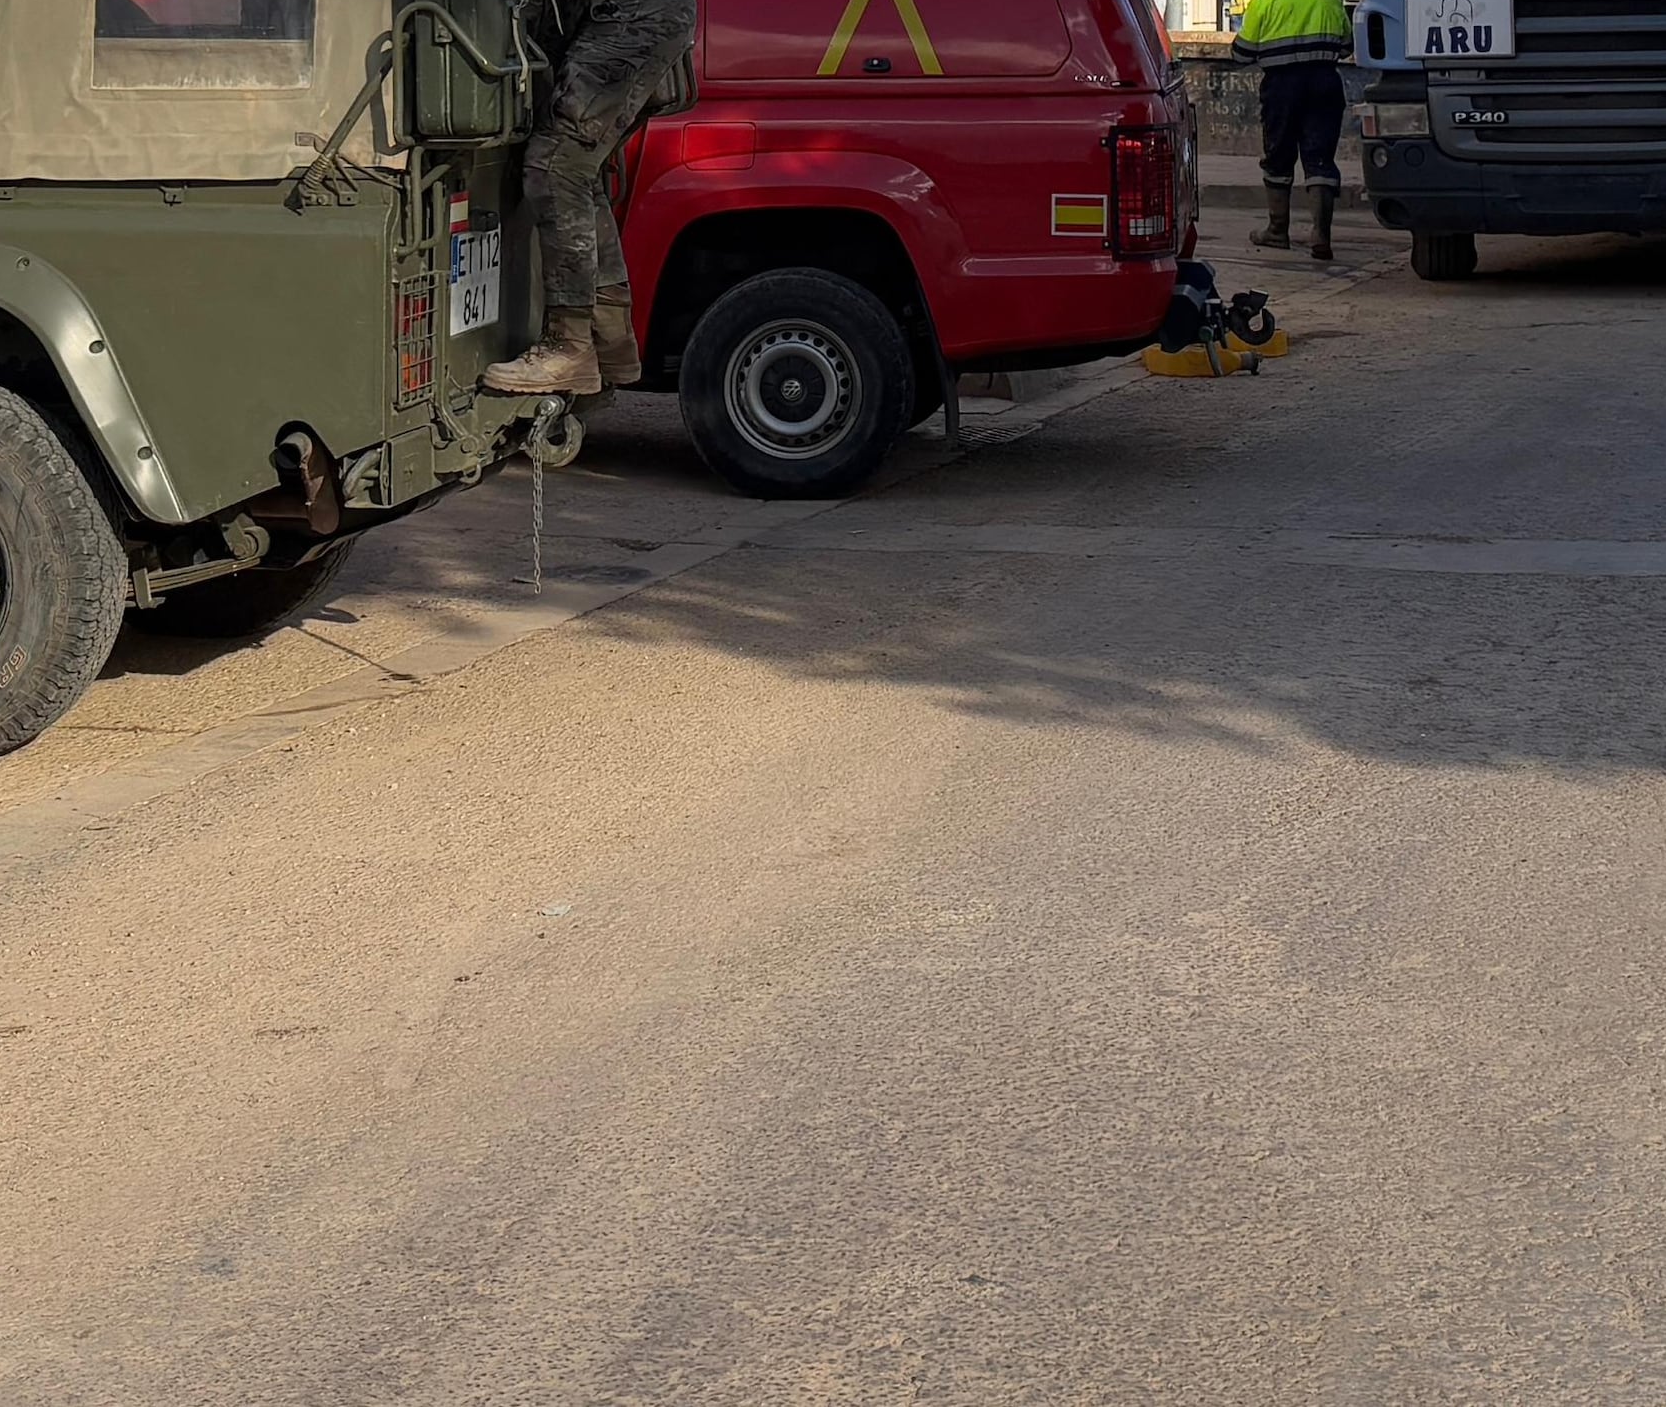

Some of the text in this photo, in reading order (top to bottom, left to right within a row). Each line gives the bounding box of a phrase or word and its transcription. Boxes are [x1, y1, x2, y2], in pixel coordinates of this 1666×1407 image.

[1424, 25, 1493, 54] ARU
[1454, 111, 1506, 124] P 340
[458, 231, 499, 277] ET 112
[463, 283, 487, 325] 841
